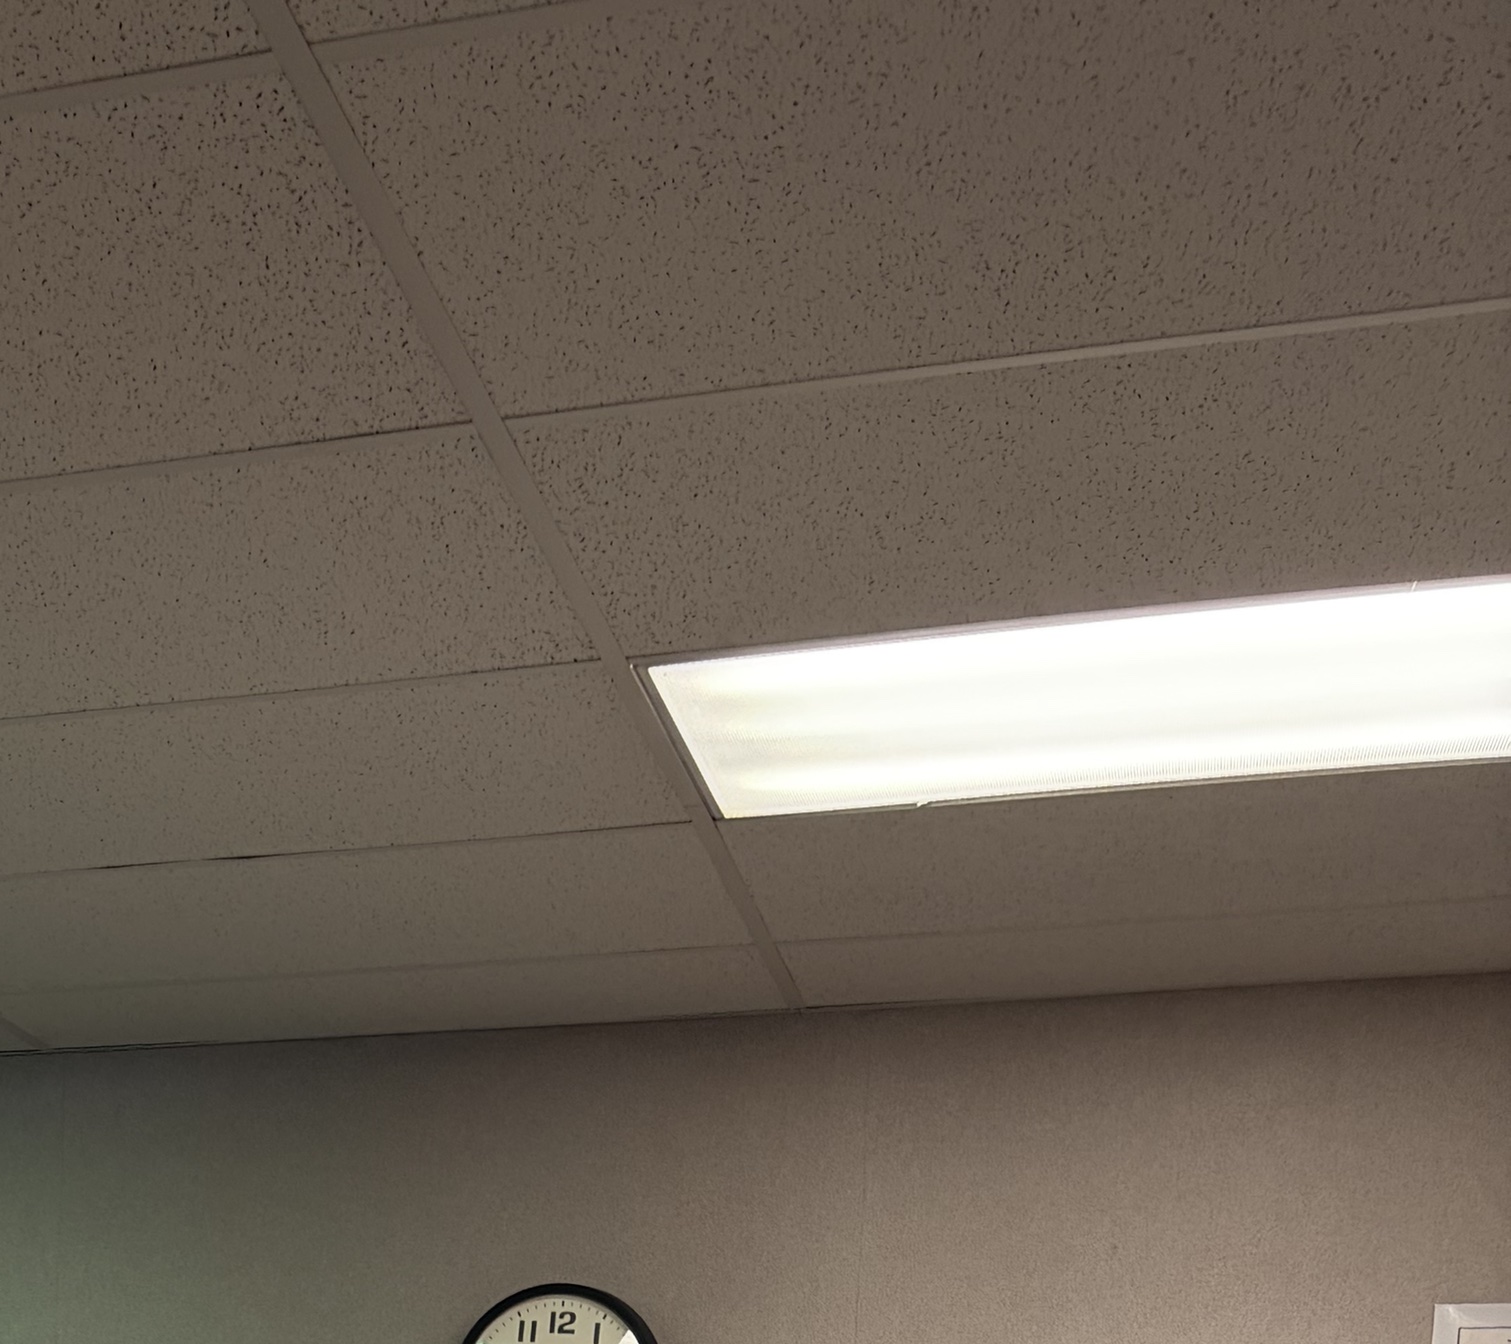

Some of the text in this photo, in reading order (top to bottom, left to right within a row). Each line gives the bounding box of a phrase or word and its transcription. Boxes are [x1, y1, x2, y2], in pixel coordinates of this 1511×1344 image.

[517, 1320, 538, 1343] 11
[549, 1311, 576, 1334] 12
[593, 1322, 601, 1344] 1
